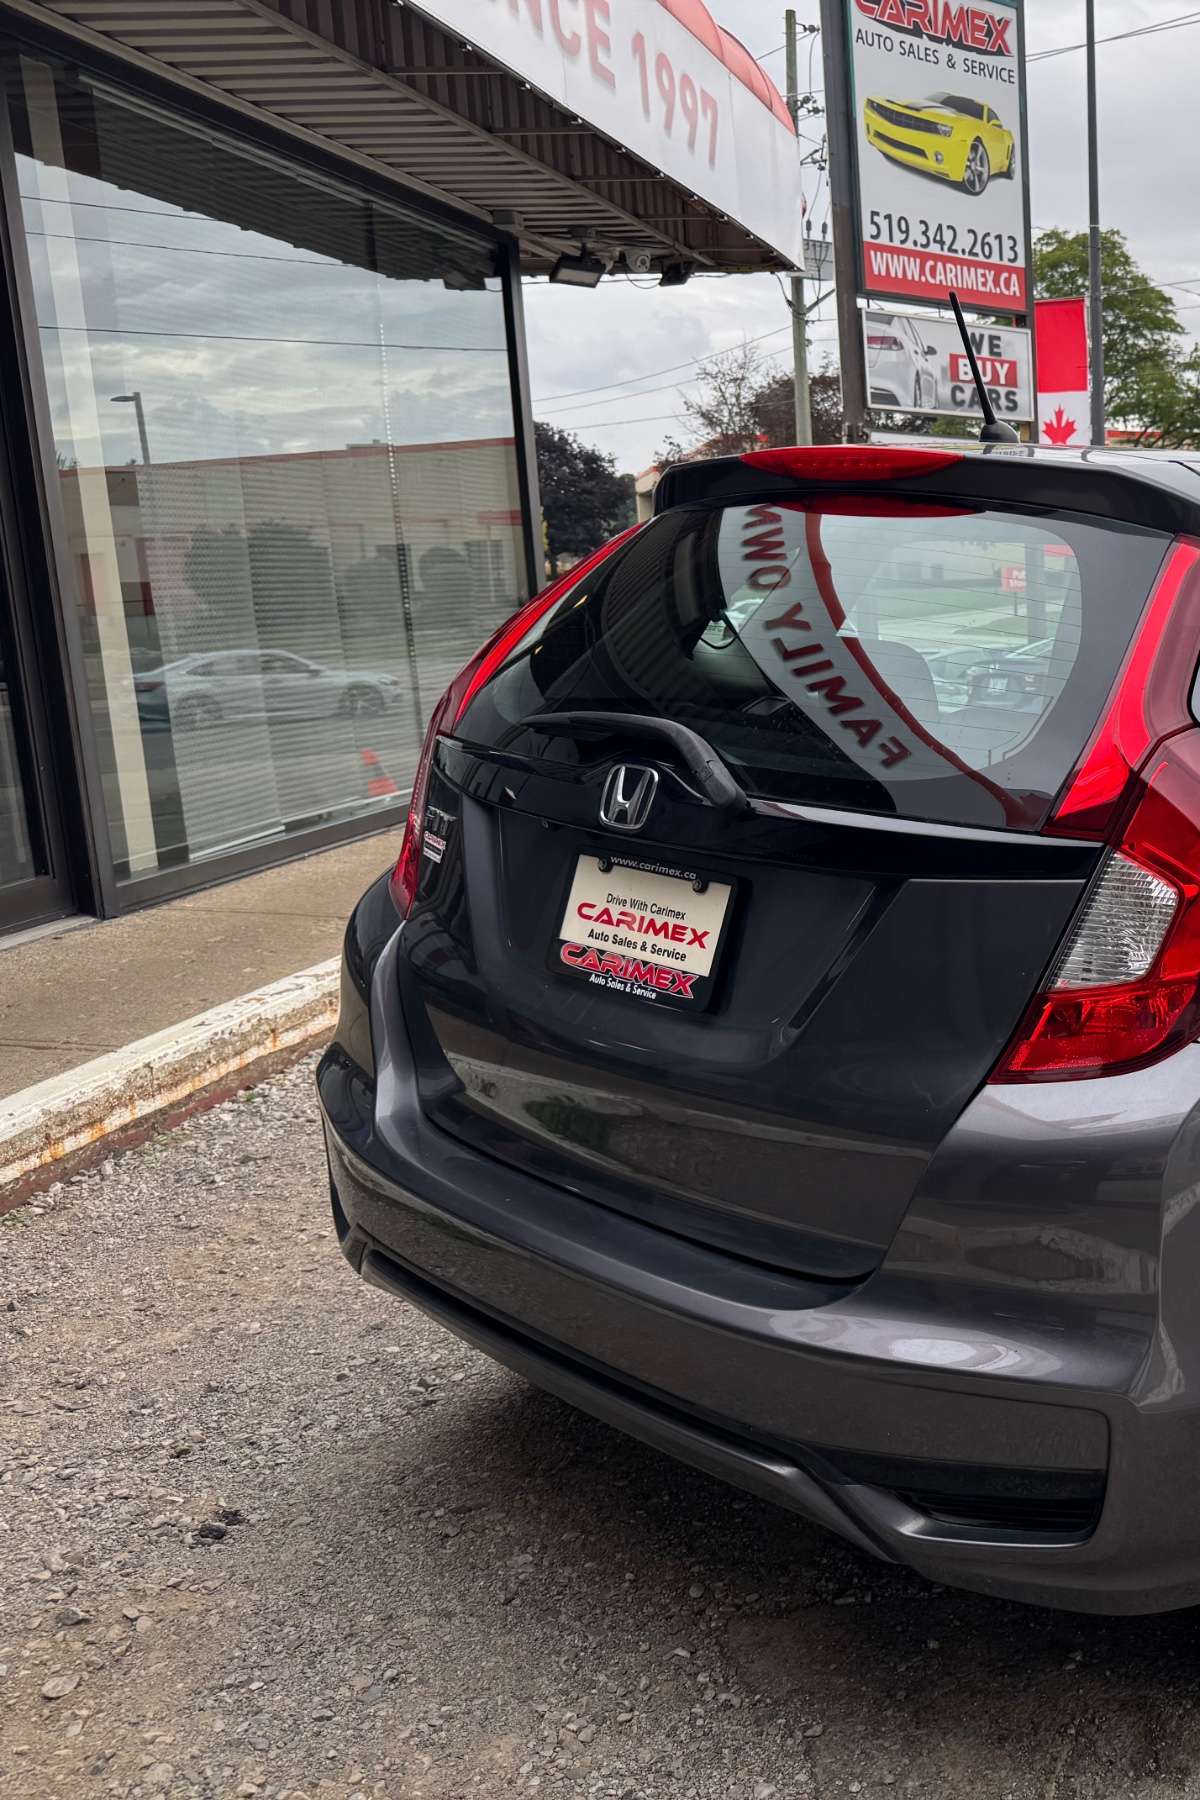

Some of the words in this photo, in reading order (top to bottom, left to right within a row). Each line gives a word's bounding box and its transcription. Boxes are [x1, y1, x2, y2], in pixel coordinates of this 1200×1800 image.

[855, 28, 894, 53] AUTO
[899, 40, 940, 65] SALES
[946, 53, 957, 70] &
[963, 57, 1015, 84] SERVICE
[632, 31, 718, 170] 1997
[870, 210, 1018, 263] 519.342.2613
[870, 250, 1020, 297] WWW.CARIMEX.CA
[957, 357, 1011, 385] BUY
[951, 384, 1018, 412] CARS
[610, 855, 697, 881] www.carimex.ca
[576, 902, 711, 950] CARIMEX
[606, 893, 628, 907] Drive
[630, 897, 649, 912] With
[650, 903, 686, 921] Carimex
[587, 928, 610, 943] Auto
[611, 933, 637, 951] Sales
[640, 940, 648, 951] &
[650, 944, 687, 962] Service
[560, 942, 699, 999] CARIMEX
[589, 973, 606, 987] Auto
[606, 977, 625, 991] Sales
[625, 983, 632, 993] &
[632, 984, 657, 1000] Service
